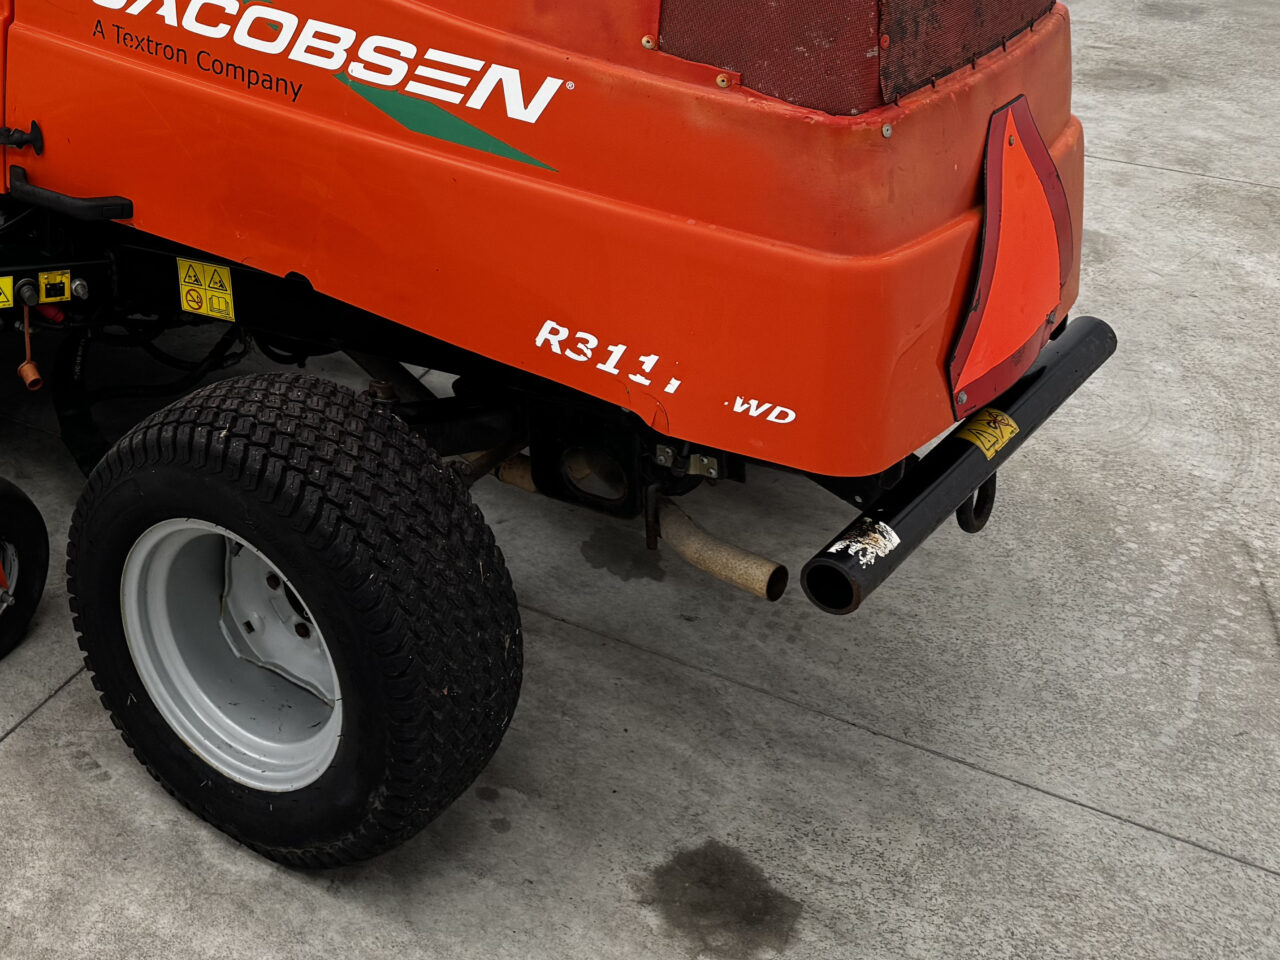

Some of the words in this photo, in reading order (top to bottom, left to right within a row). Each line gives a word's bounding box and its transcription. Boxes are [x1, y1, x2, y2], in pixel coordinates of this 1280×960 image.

[92, 19, 105, 40] A
[112, 23, 188, 65] Textron
[196, 50, 303, 103] Company
[723, 396, 797, 424] WD
